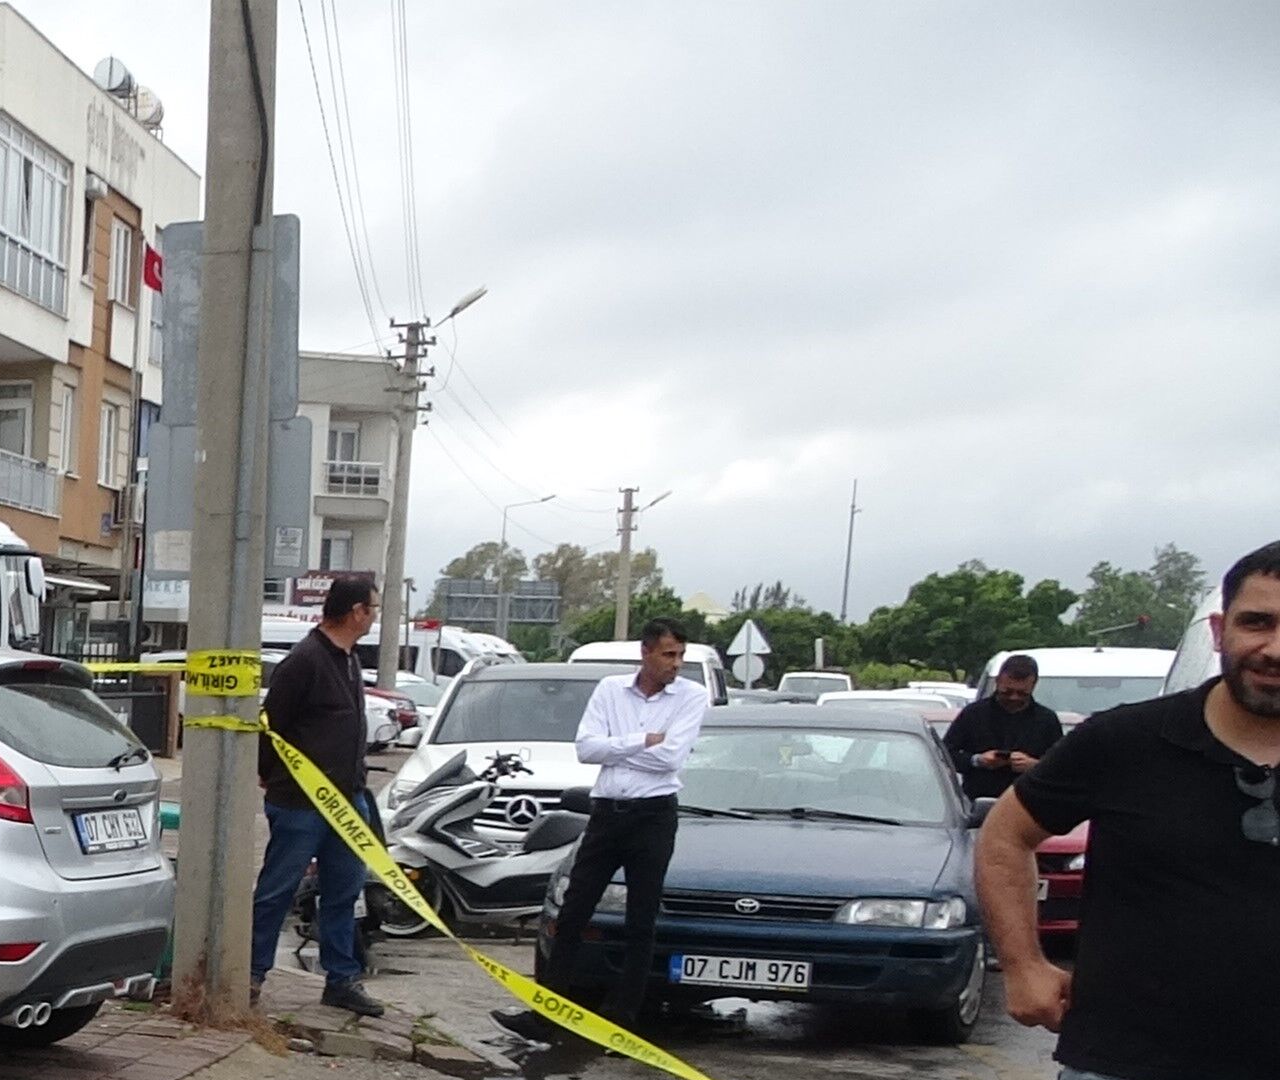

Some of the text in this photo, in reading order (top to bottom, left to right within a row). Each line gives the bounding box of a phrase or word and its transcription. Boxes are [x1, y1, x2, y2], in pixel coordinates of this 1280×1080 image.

[315, 786, 375, 852] GİRİLMEZ
[683, 957, 806, 985] 07 CJM 976
